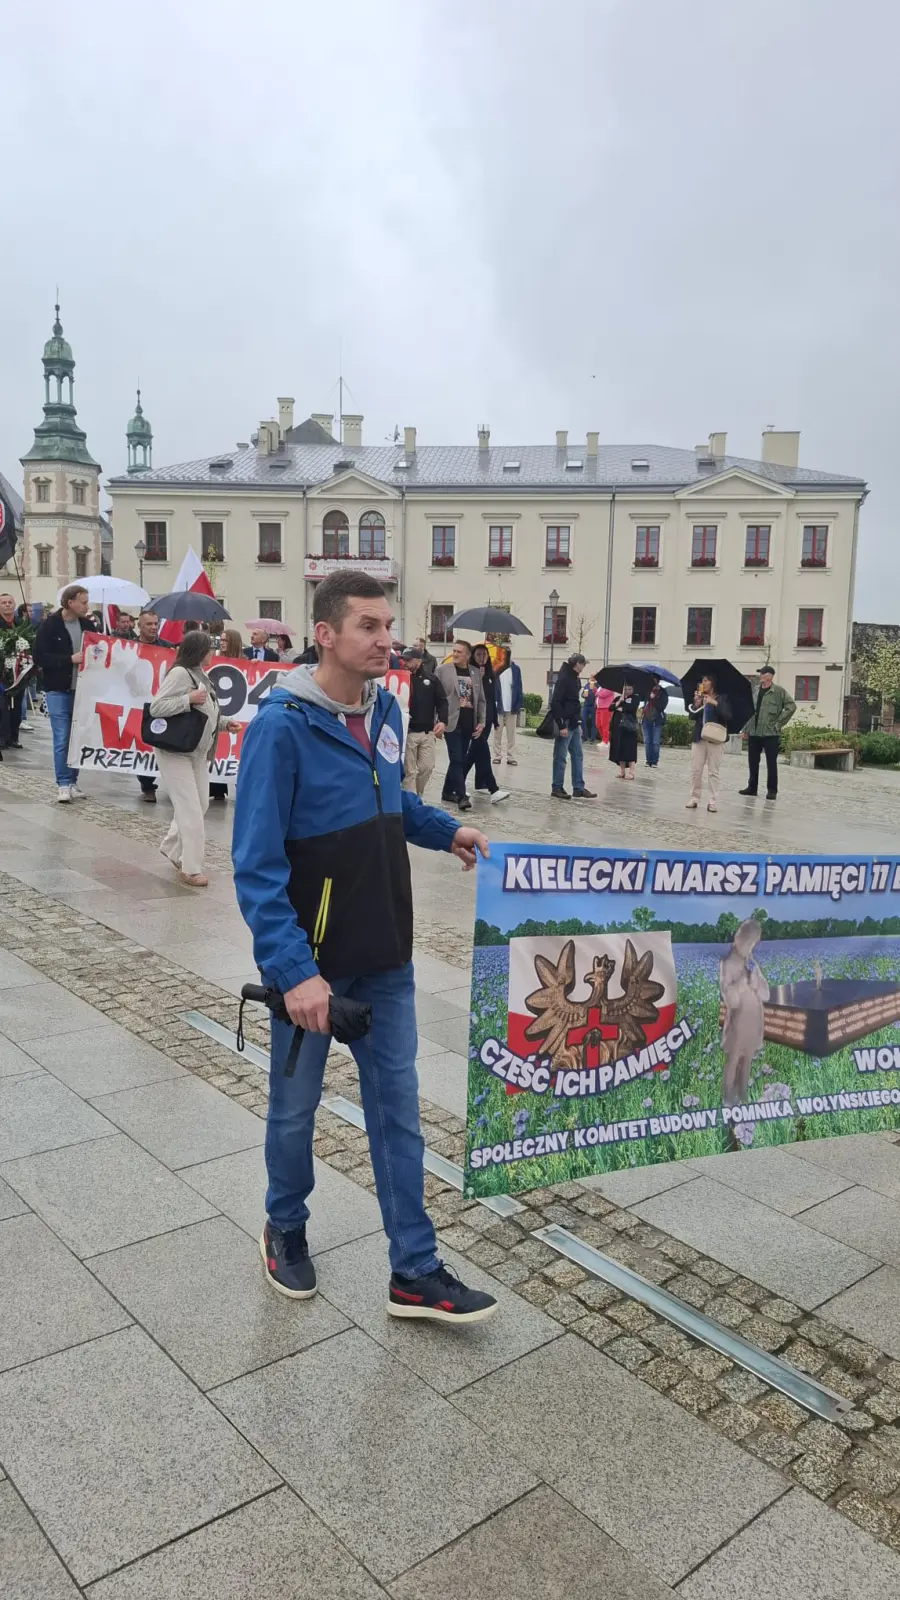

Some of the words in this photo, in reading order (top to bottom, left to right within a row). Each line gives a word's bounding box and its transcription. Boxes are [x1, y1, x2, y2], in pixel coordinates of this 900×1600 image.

[504, 856, 647, 891] KIELECKI
[653, 861, 758, 893] MARSZ
[765, 864, 867, 899] PAMIĘCI
[870, 864, 890, 890] 11
[479, 1038, 549, 1093] CZEŚĆ
[554, 1069, 596, 1097] ICH
[599, 1019, 693, 1090] PAMIĘCI
[469, 1130, 569, 1169] SPOŁECZNY
[573, 1118, 649, 1148] KOMITET
[650, 1109, 718, 1136] BUDOWY
[721, 1100, 794, 1125] POMNIKA
[796, 1088, 900, 1115] WOŁYŃSKIEGO
